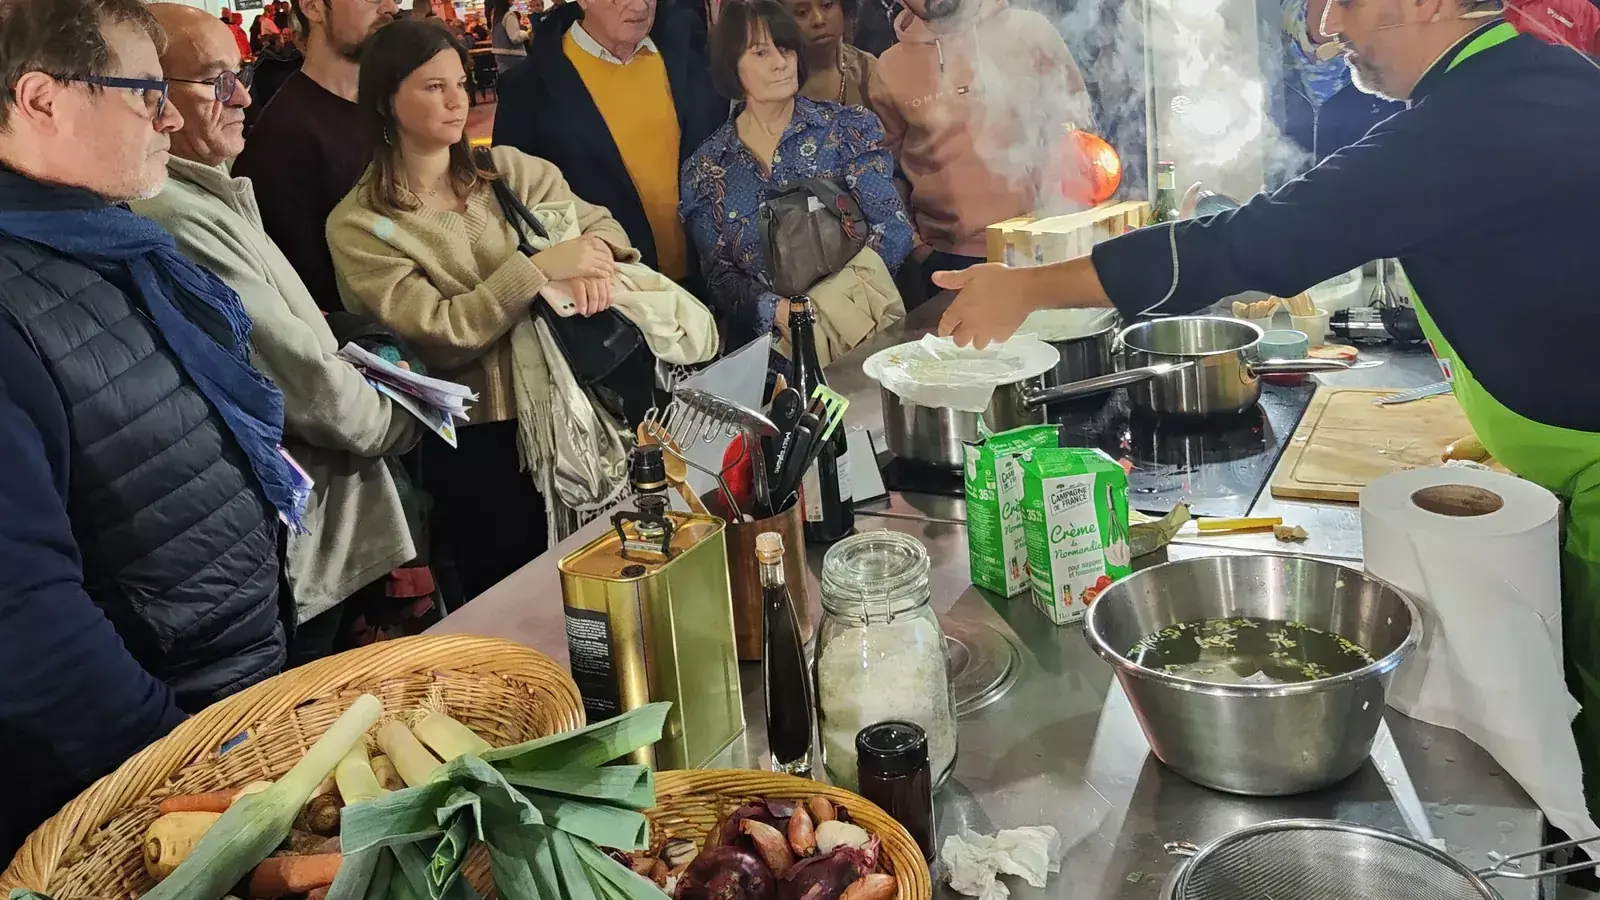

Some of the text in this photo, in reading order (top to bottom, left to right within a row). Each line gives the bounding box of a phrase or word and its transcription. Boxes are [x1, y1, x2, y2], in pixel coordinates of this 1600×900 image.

[1050, 486, 1088, 505] CAMPAGNE
[1062, 493, 1088, 508] FRANCE
[1050, 522, 1097, 544] Crème
[1054, 540, 1104, 560] Normandie
